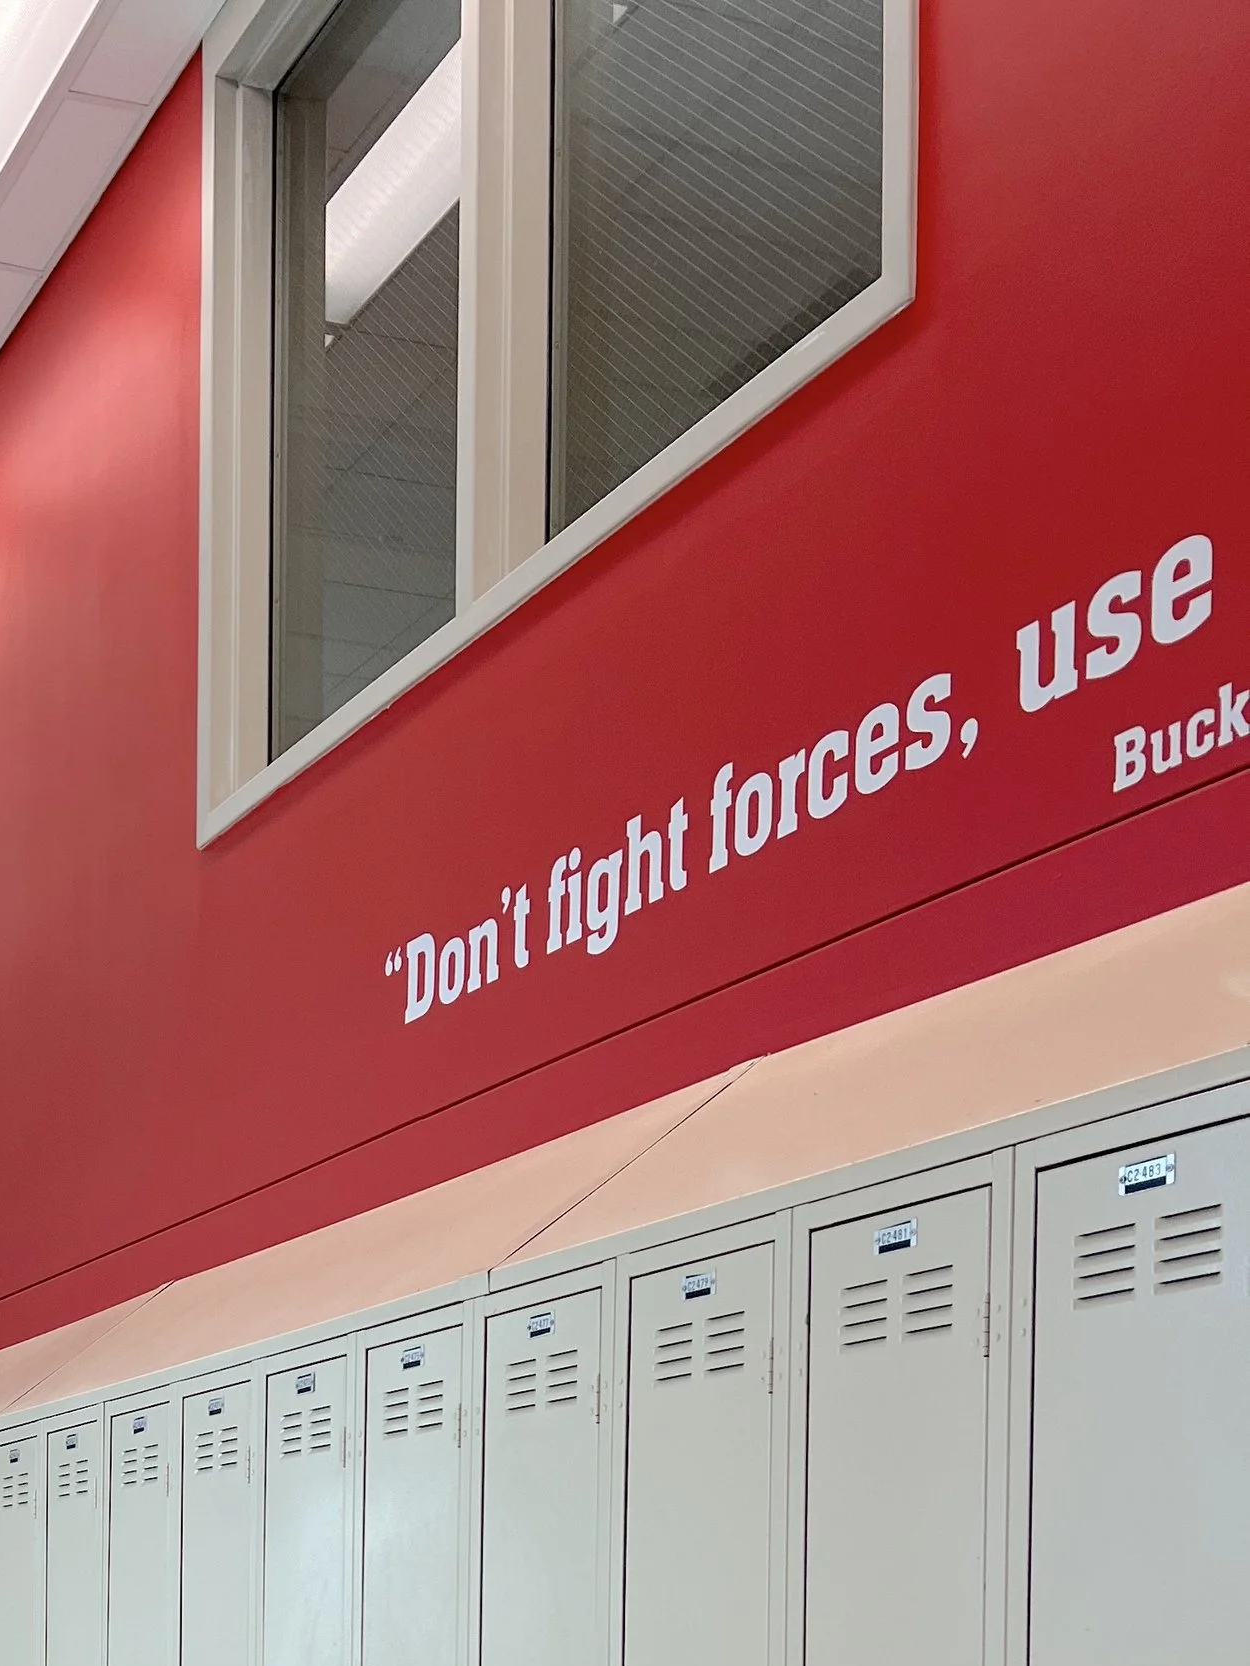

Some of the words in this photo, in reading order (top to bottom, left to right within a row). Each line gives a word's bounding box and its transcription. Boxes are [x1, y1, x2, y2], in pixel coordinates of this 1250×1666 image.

[384, 883, 531, 1025] “Don’t
[546, 796, 689, 956] fight
[708, 673, 979, 874] forces,
[1016, 534, 1213, 713] use
[1112, 681, 1250, 793] Buck
